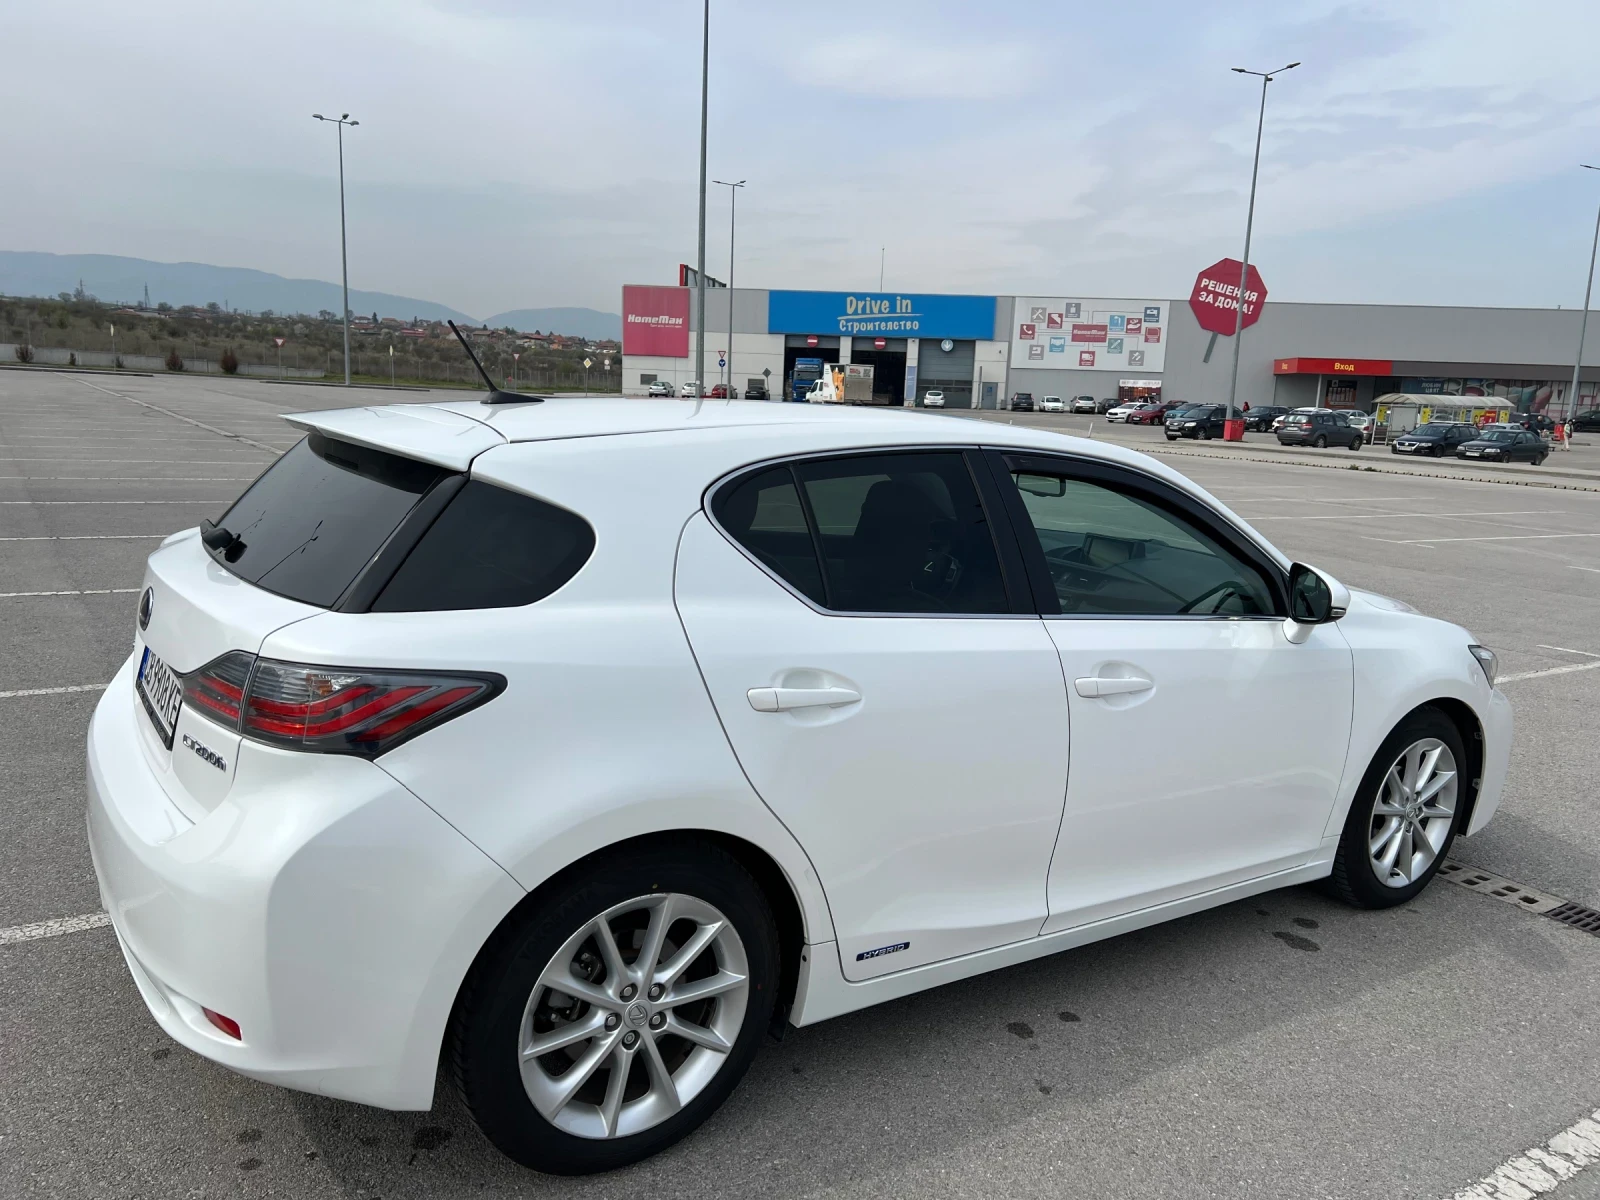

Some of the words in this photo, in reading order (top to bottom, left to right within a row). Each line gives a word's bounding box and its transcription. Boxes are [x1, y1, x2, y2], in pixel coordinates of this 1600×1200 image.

[1200, 278, 1258, 302] РЕШЕНИЯ
[846, 296, 890, 314] Drive
[896, 296, 912, 313] in
[1199, 291, 1214, 304] ЗА
[1214, 296, 1254, 315] ДОМА!
[627, 314, 683, 325] HomeMax
[839, 319, 920, 333] Строителство
[1334, 362, 1355, 371] Вход
[863, 944, 905, 960] HYBRID
